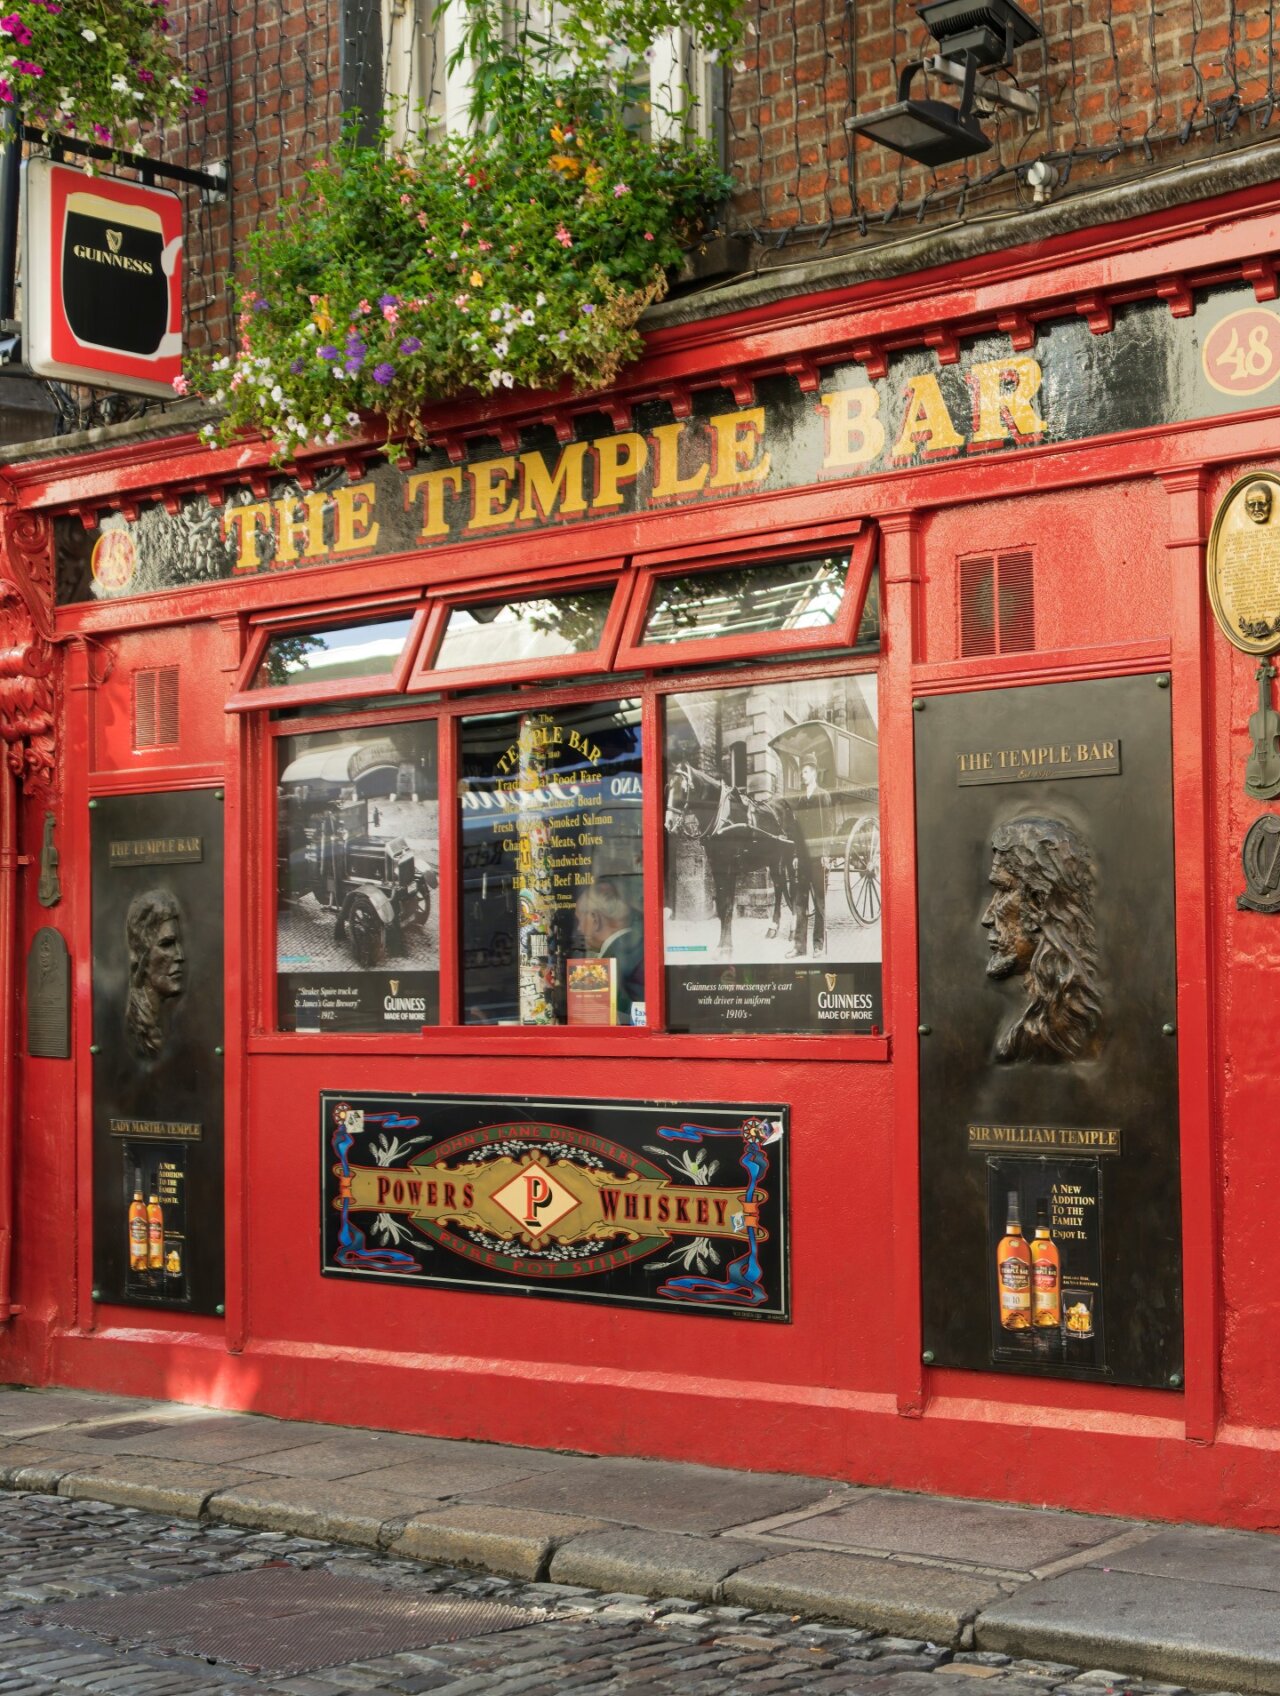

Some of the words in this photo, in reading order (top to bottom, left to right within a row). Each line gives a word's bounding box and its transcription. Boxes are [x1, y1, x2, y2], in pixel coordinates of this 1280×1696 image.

[73, 244, 153, 275] GUINNESS
[1216, 325, 1273, 381] 48
[222, 482, 381, 572] THE
[406, 406, 772, 543] TEMPLE
[818, 356, 1048, 473] BAR
[539, 714, 554, 724] The
[568, 729, 603, 767] BAR
[957, 751, 993, 771] THE
[997, 745, 1072, 768] TEMPLE
[1077, 741, 1116, 762] BAR
[552, 771, 577, 785] Food
[580, 770, 602, 784] Fare
[577, 793, 603, 807] Board
[493, 821, 514, 833] Fresh
[549, 814, 580, 830] Smoked
[582, 813, 614, 826] Salmon
[111, 841, 129, 856] THE
[133, 838, 176, 856] TEMPLE
[177, 837, 200, 852] BAR
[578, 832, 603, 846] Olives
[546, 853, 592, 868] Sandwiches
[554, 873, 572, 887] Beef
[574, 872, 595, 886] Rolls
[718, 982, 735, 992] town
[777, 982, 793, 992] cart
[322, 999, 335, 1008] Gate
[384, 995, 426, 1011] GUINNESS
[698, 995, 713, 1006] with
[713, 995, 735, 1006] driver
[735, 995, 743, 1005] in
[817, 991, 873, 1010] GUINNESS
[321, 1010, 335, 1020] 1912
[384, 1012, 400, 1021] MADE
[400, 1012, 408, 1021] OF
[408, 1012, 426, 1021] MORE
[817, 1010, 840, 1020] MADE
[840, 1010, 850, 1020] OF
[851, 1010, 873, 1020] MORE
[111, 1121, 131, 1133] LADY
[131, 1121, 166, 1135] MARTHA
[166, 1122, 200, 1136] TEMPLE
[969, 1126, 991, 1142] SIR
[992, 1127, 1056, 1144] WILLIAM
[1058, 1130, 1118, 1146] TEMPLE
[435, 1129, 490, 1159] JOHN'S
[499, 1125, 542, 1139] LANE
[550, 1127, 642, 1169] DISTILLERY
[1051, 1183, 1058, 1194] A
[377, 1175, 475, 1211] POWERS
[521, 1174, 554, 1229] P
[600, 1187, 730, 1228] WHISKEY
[1066, 1206, 1085, 1216] THE
[439, 1232, 498, 1265] PURE
[512, 1260, 560, 1275] POT
[572, 1250, 637, 1275] STILL
